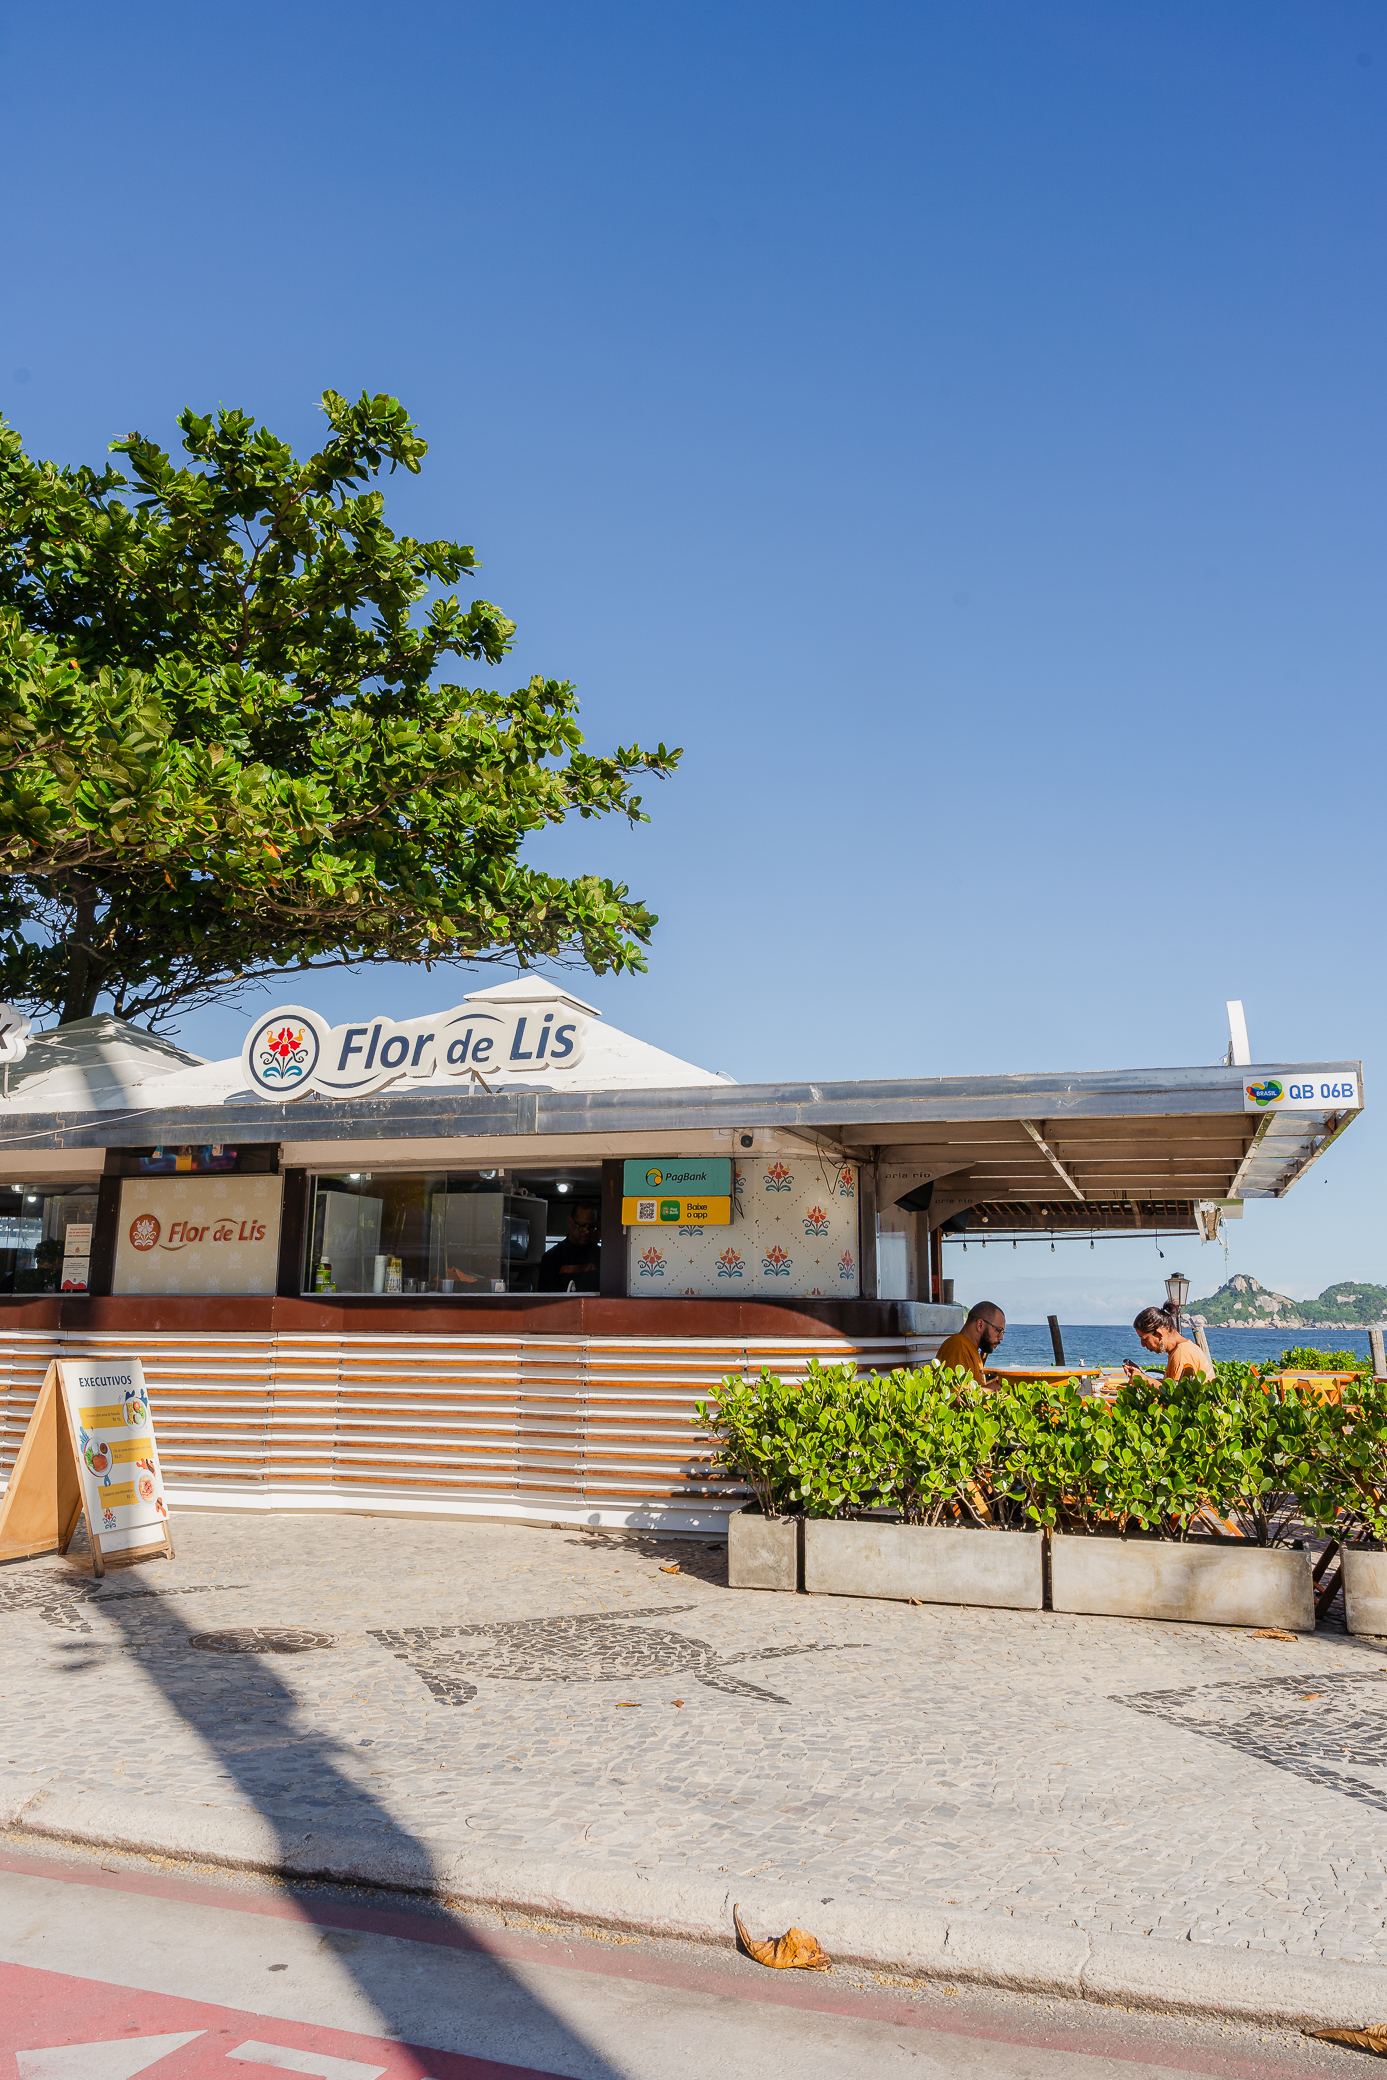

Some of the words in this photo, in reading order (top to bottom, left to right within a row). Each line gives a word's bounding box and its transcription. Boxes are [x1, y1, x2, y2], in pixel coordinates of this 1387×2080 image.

[337, 1024, 435, 1070] Flor
[446, 1028, 494, 1064] de
[509, 1013, 577, 1060] Lis
[1289, 1084, 1314, 1100] QB
[1320, 1083, 1353, 1098] 06B
[665, 1172, 708, 1183] PagBank
[168, 1222, 211, 1243] Flor
[212, 1224, 234, 1242] de
[238, 1219, 267, 1241] Lis
[78, 1375, 132, 1387] EXECUTIVOS
